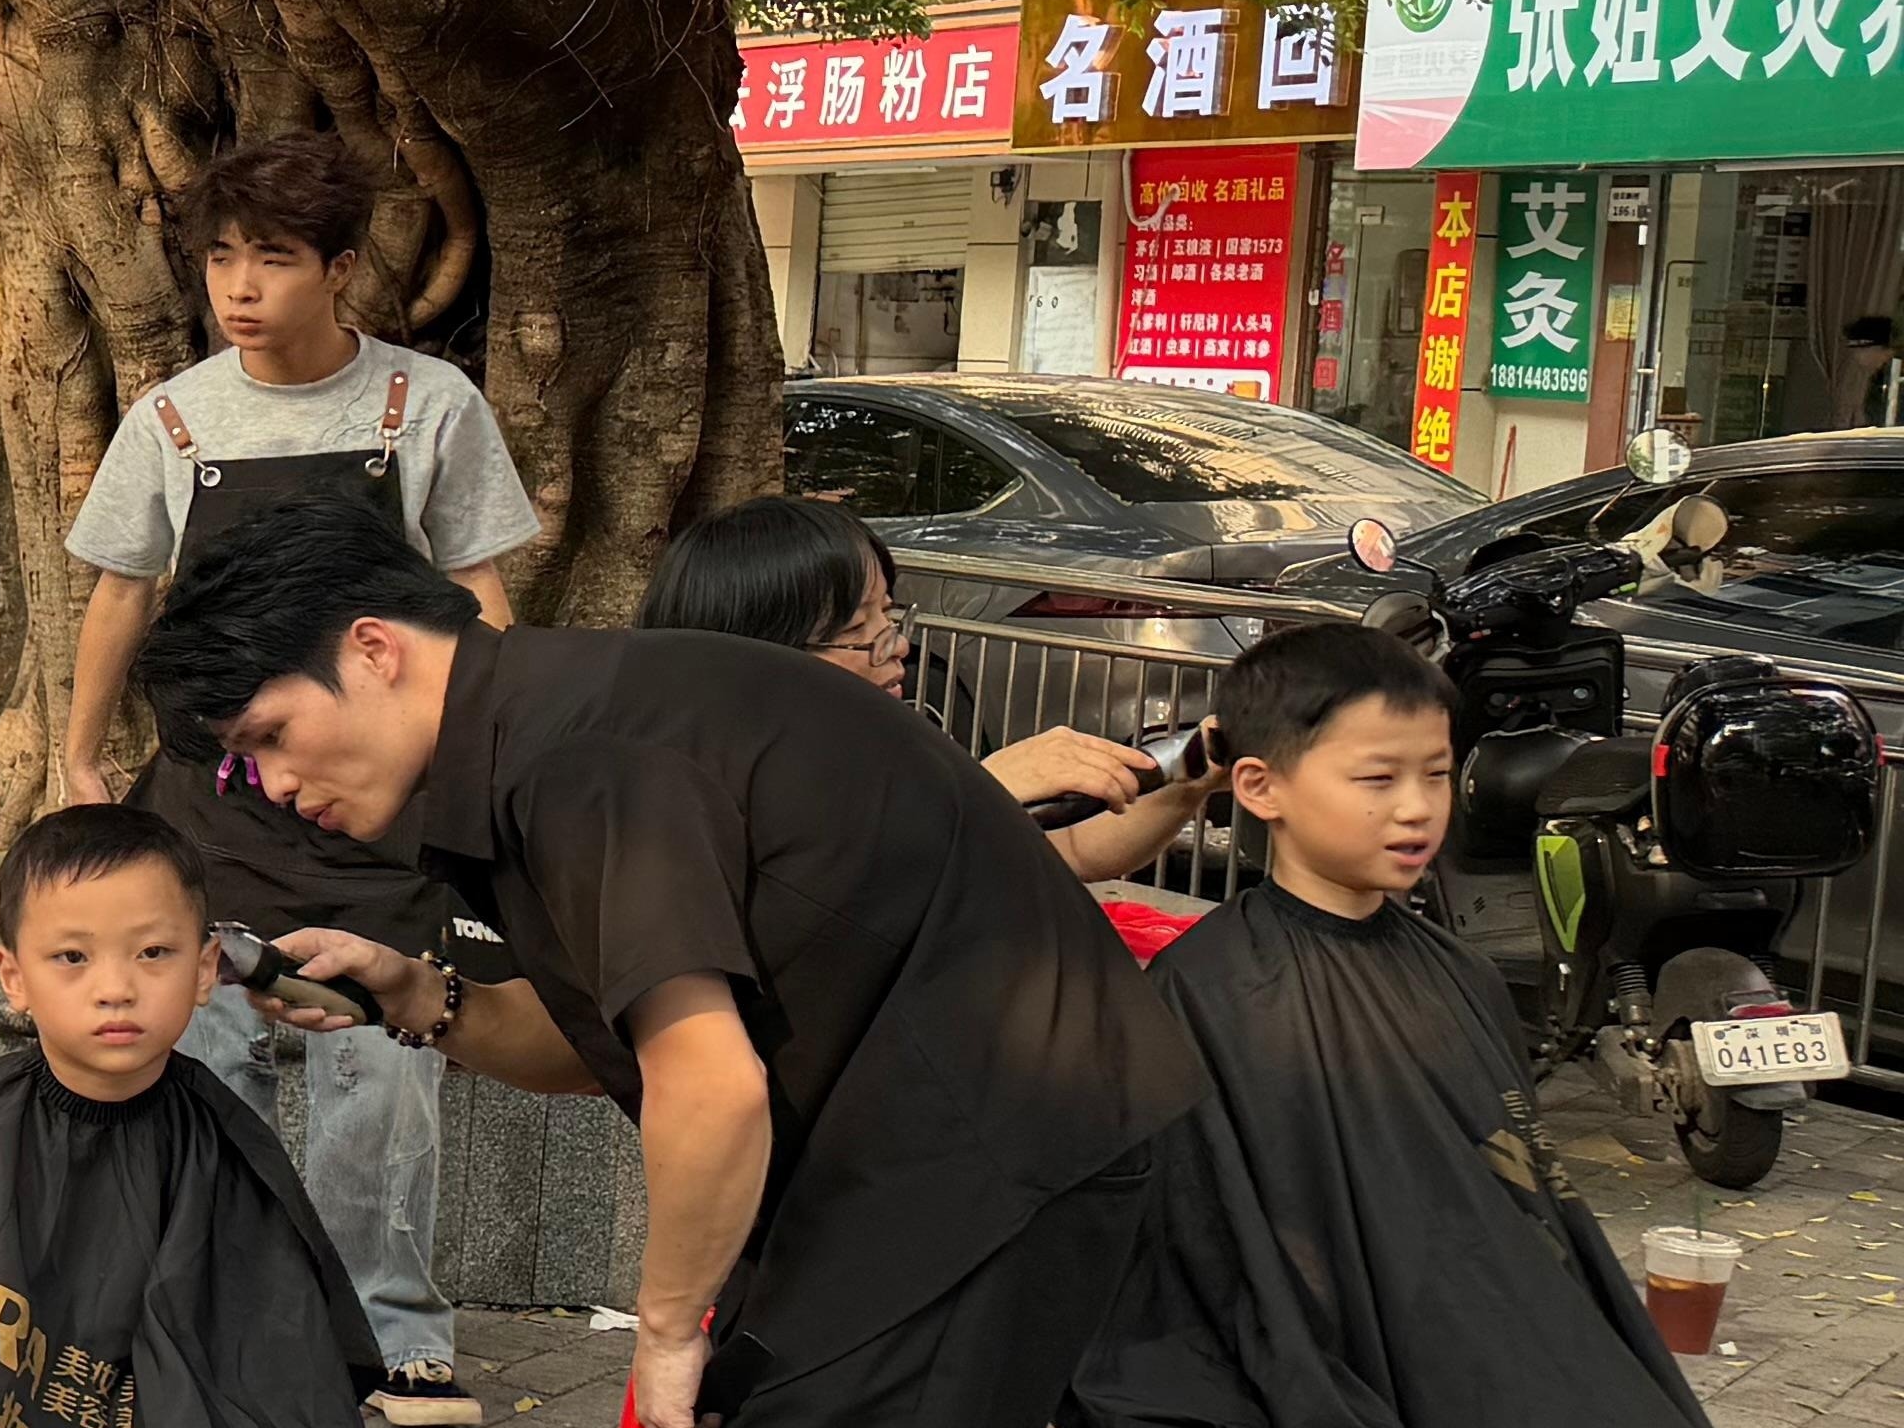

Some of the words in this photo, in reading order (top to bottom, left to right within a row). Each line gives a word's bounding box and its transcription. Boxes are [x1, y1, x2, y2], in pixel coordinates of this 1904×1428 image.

[1213, 176, 1284, 203] 名酒礼品
[1501, 182, 1586, 353] 艾灸
[1415, 190, 1474, 463] 本店谢绝
[1490, 363, 1588, 393] 18814483696
[1718, 1040, 1827, 1068] 041E83
